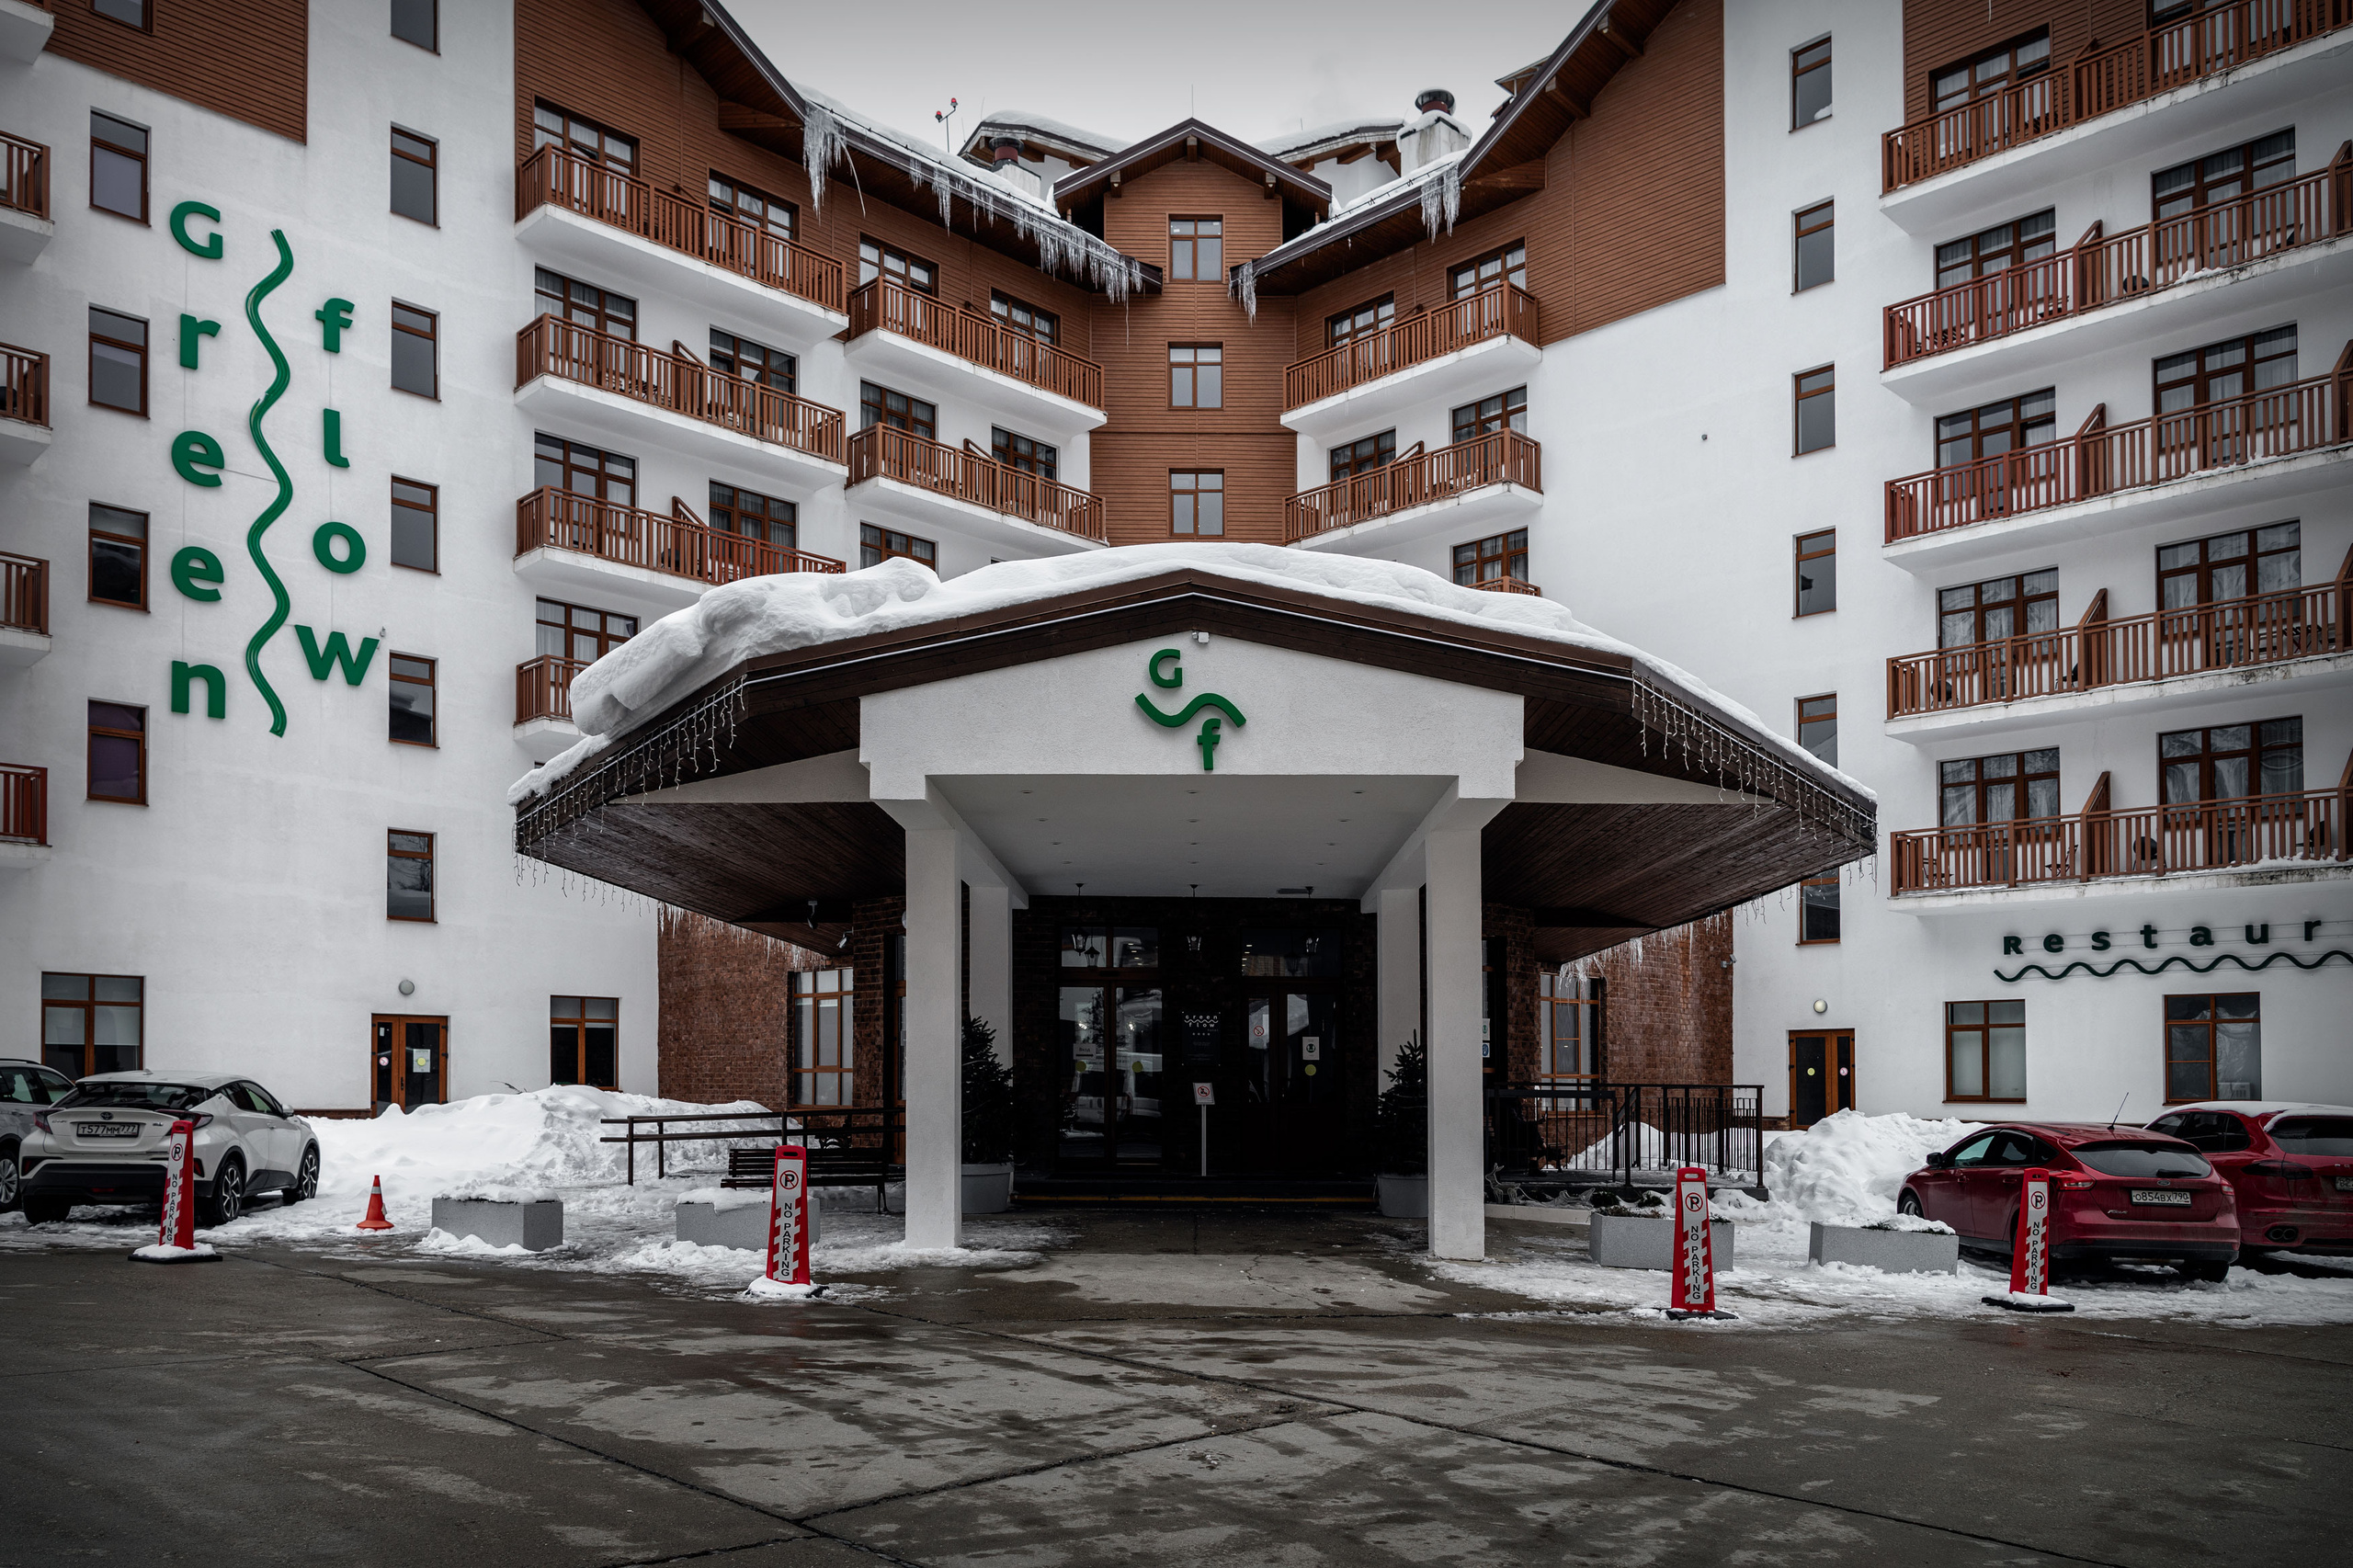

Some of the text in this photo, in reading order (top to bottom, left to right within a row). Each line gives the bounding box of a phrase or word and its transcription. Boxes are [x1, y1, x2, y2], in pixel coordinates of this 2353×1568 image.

[170, 200, 225, 720] Green
[294, 297, 380, 687] flow
[2003, 919, 2322, 955] Restaur
[166, 1173, 178, 1242] NO PARKING
[781, 1202, 792, 1277] NO PARKING
[1690, 1225, 1700, 1300] NO PARKING
[2029, 1221, 2040, 1290] NO PARKING
